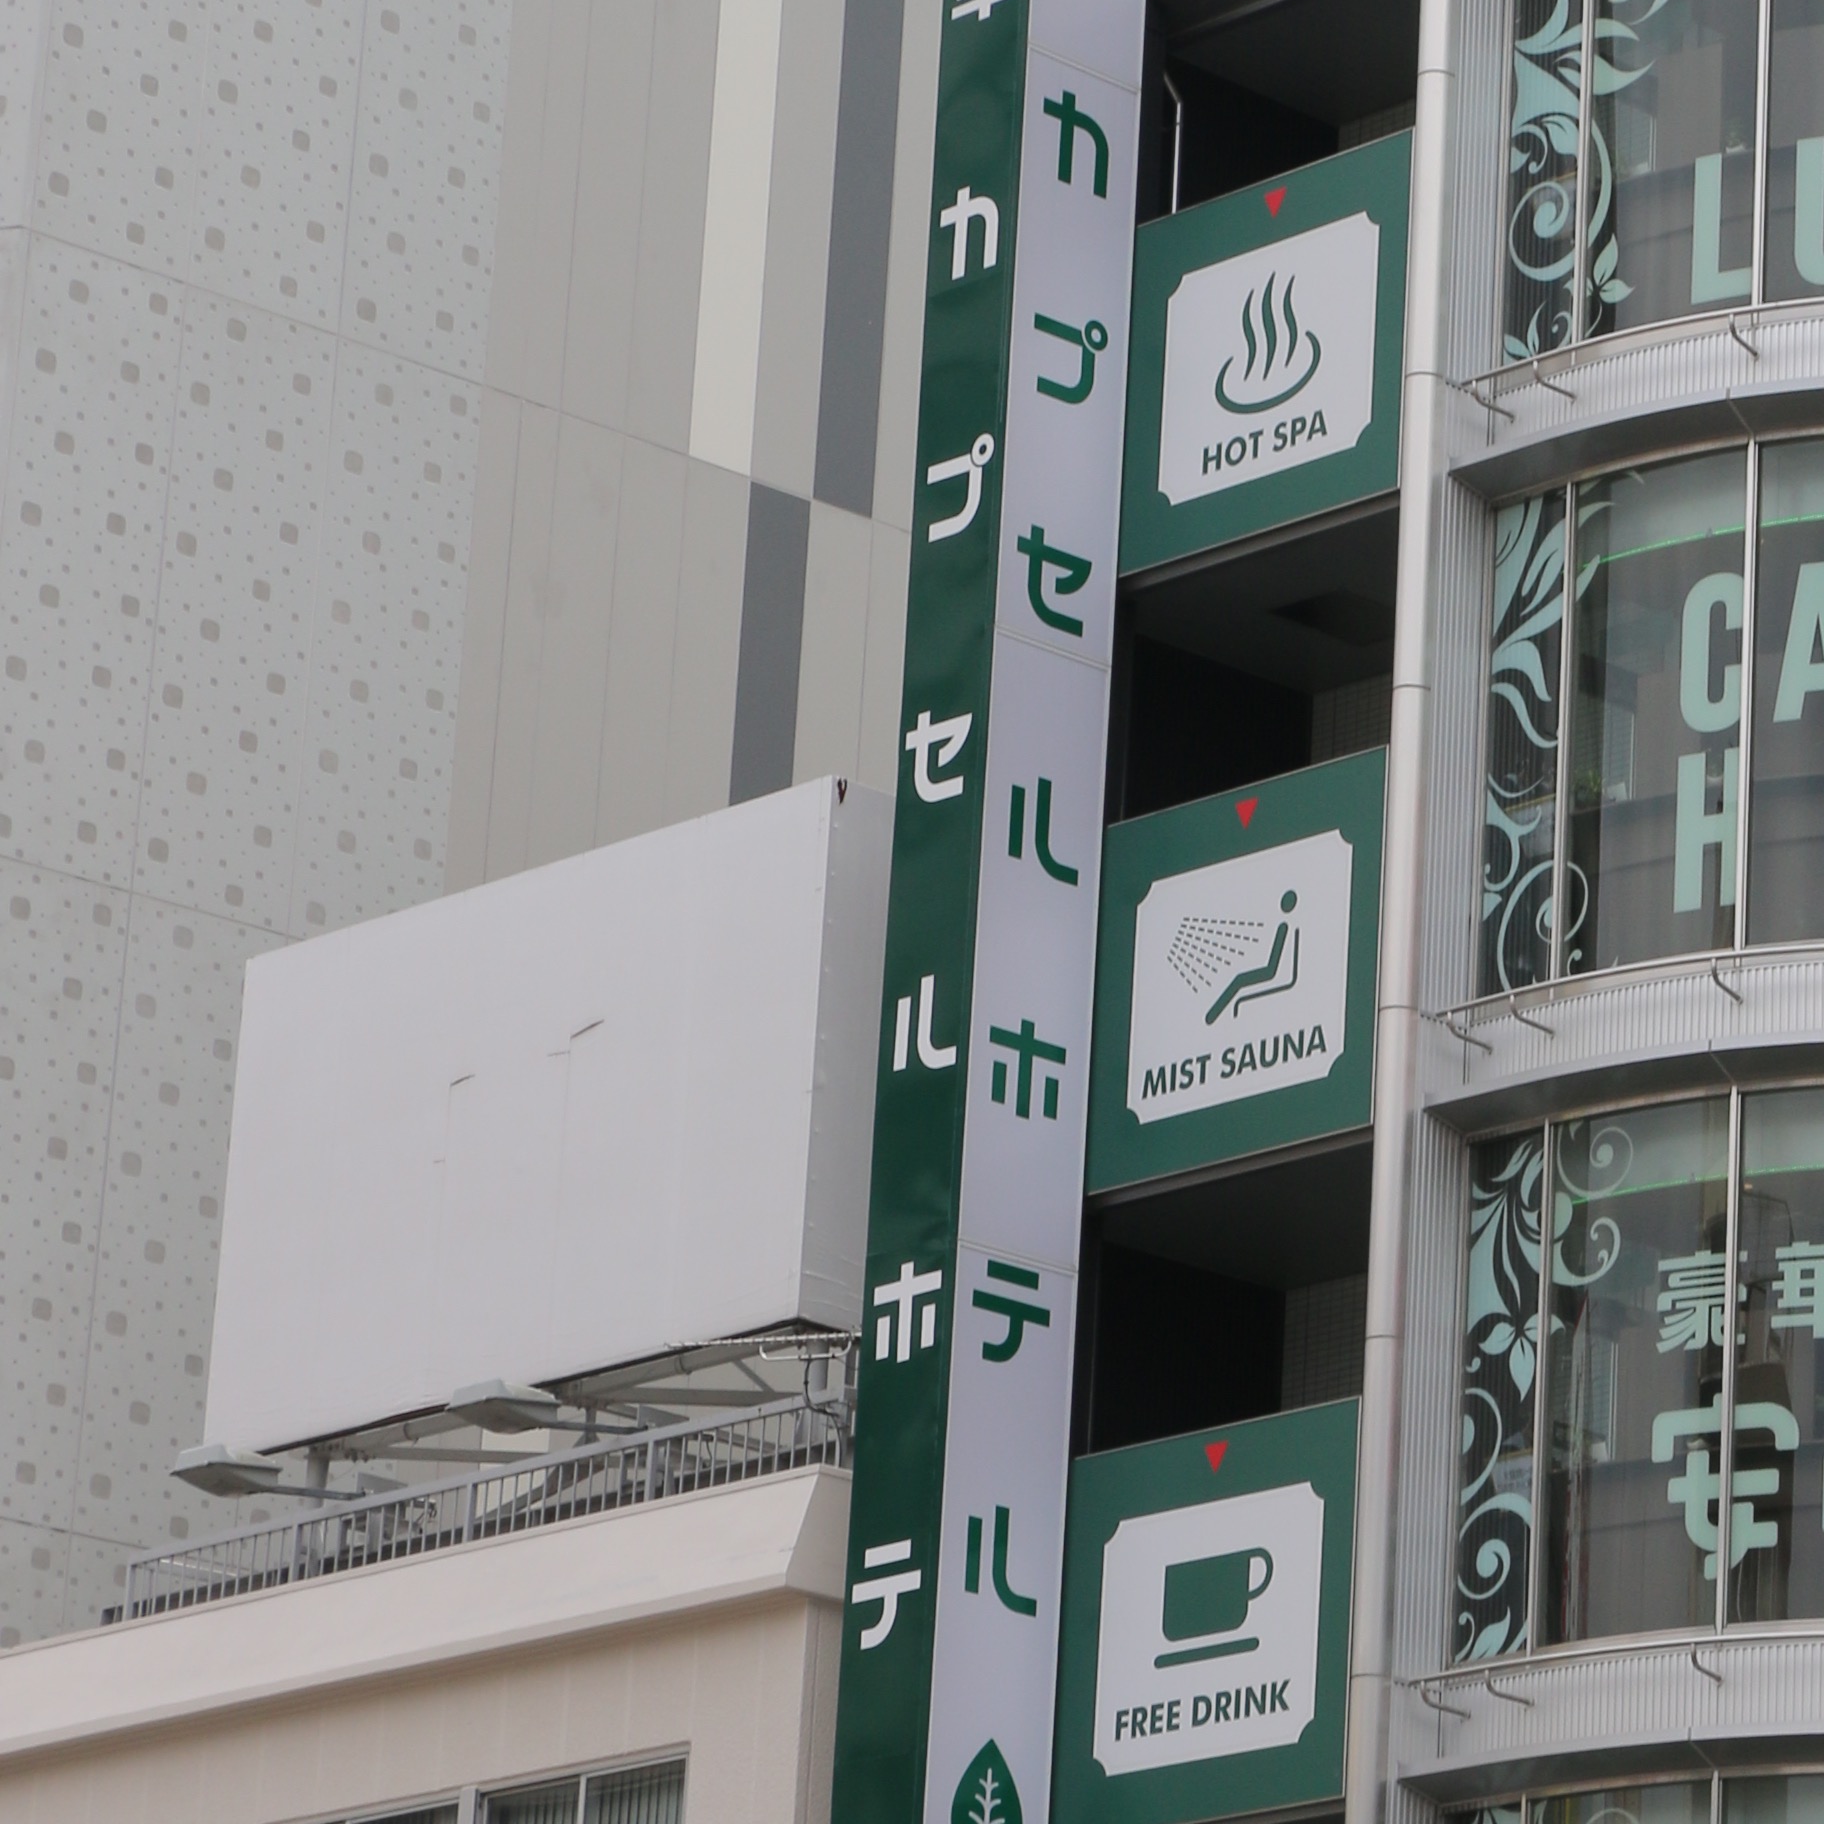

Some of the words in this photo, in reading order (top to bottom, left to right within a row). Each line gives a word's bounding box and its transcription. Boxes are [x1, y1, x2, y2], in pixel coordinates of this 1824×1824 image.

[1201, 427, 1265, 477] HOT
[1272, 408, 1329, 454] SPA
[1141, 1052, 1213, 1101] MIST
[1219, 1023, 1328, 1080] SAUNA
[1114, 1698, 1182, 1743] FREE
[1191, 1678, 1291, 1729] DRINK
